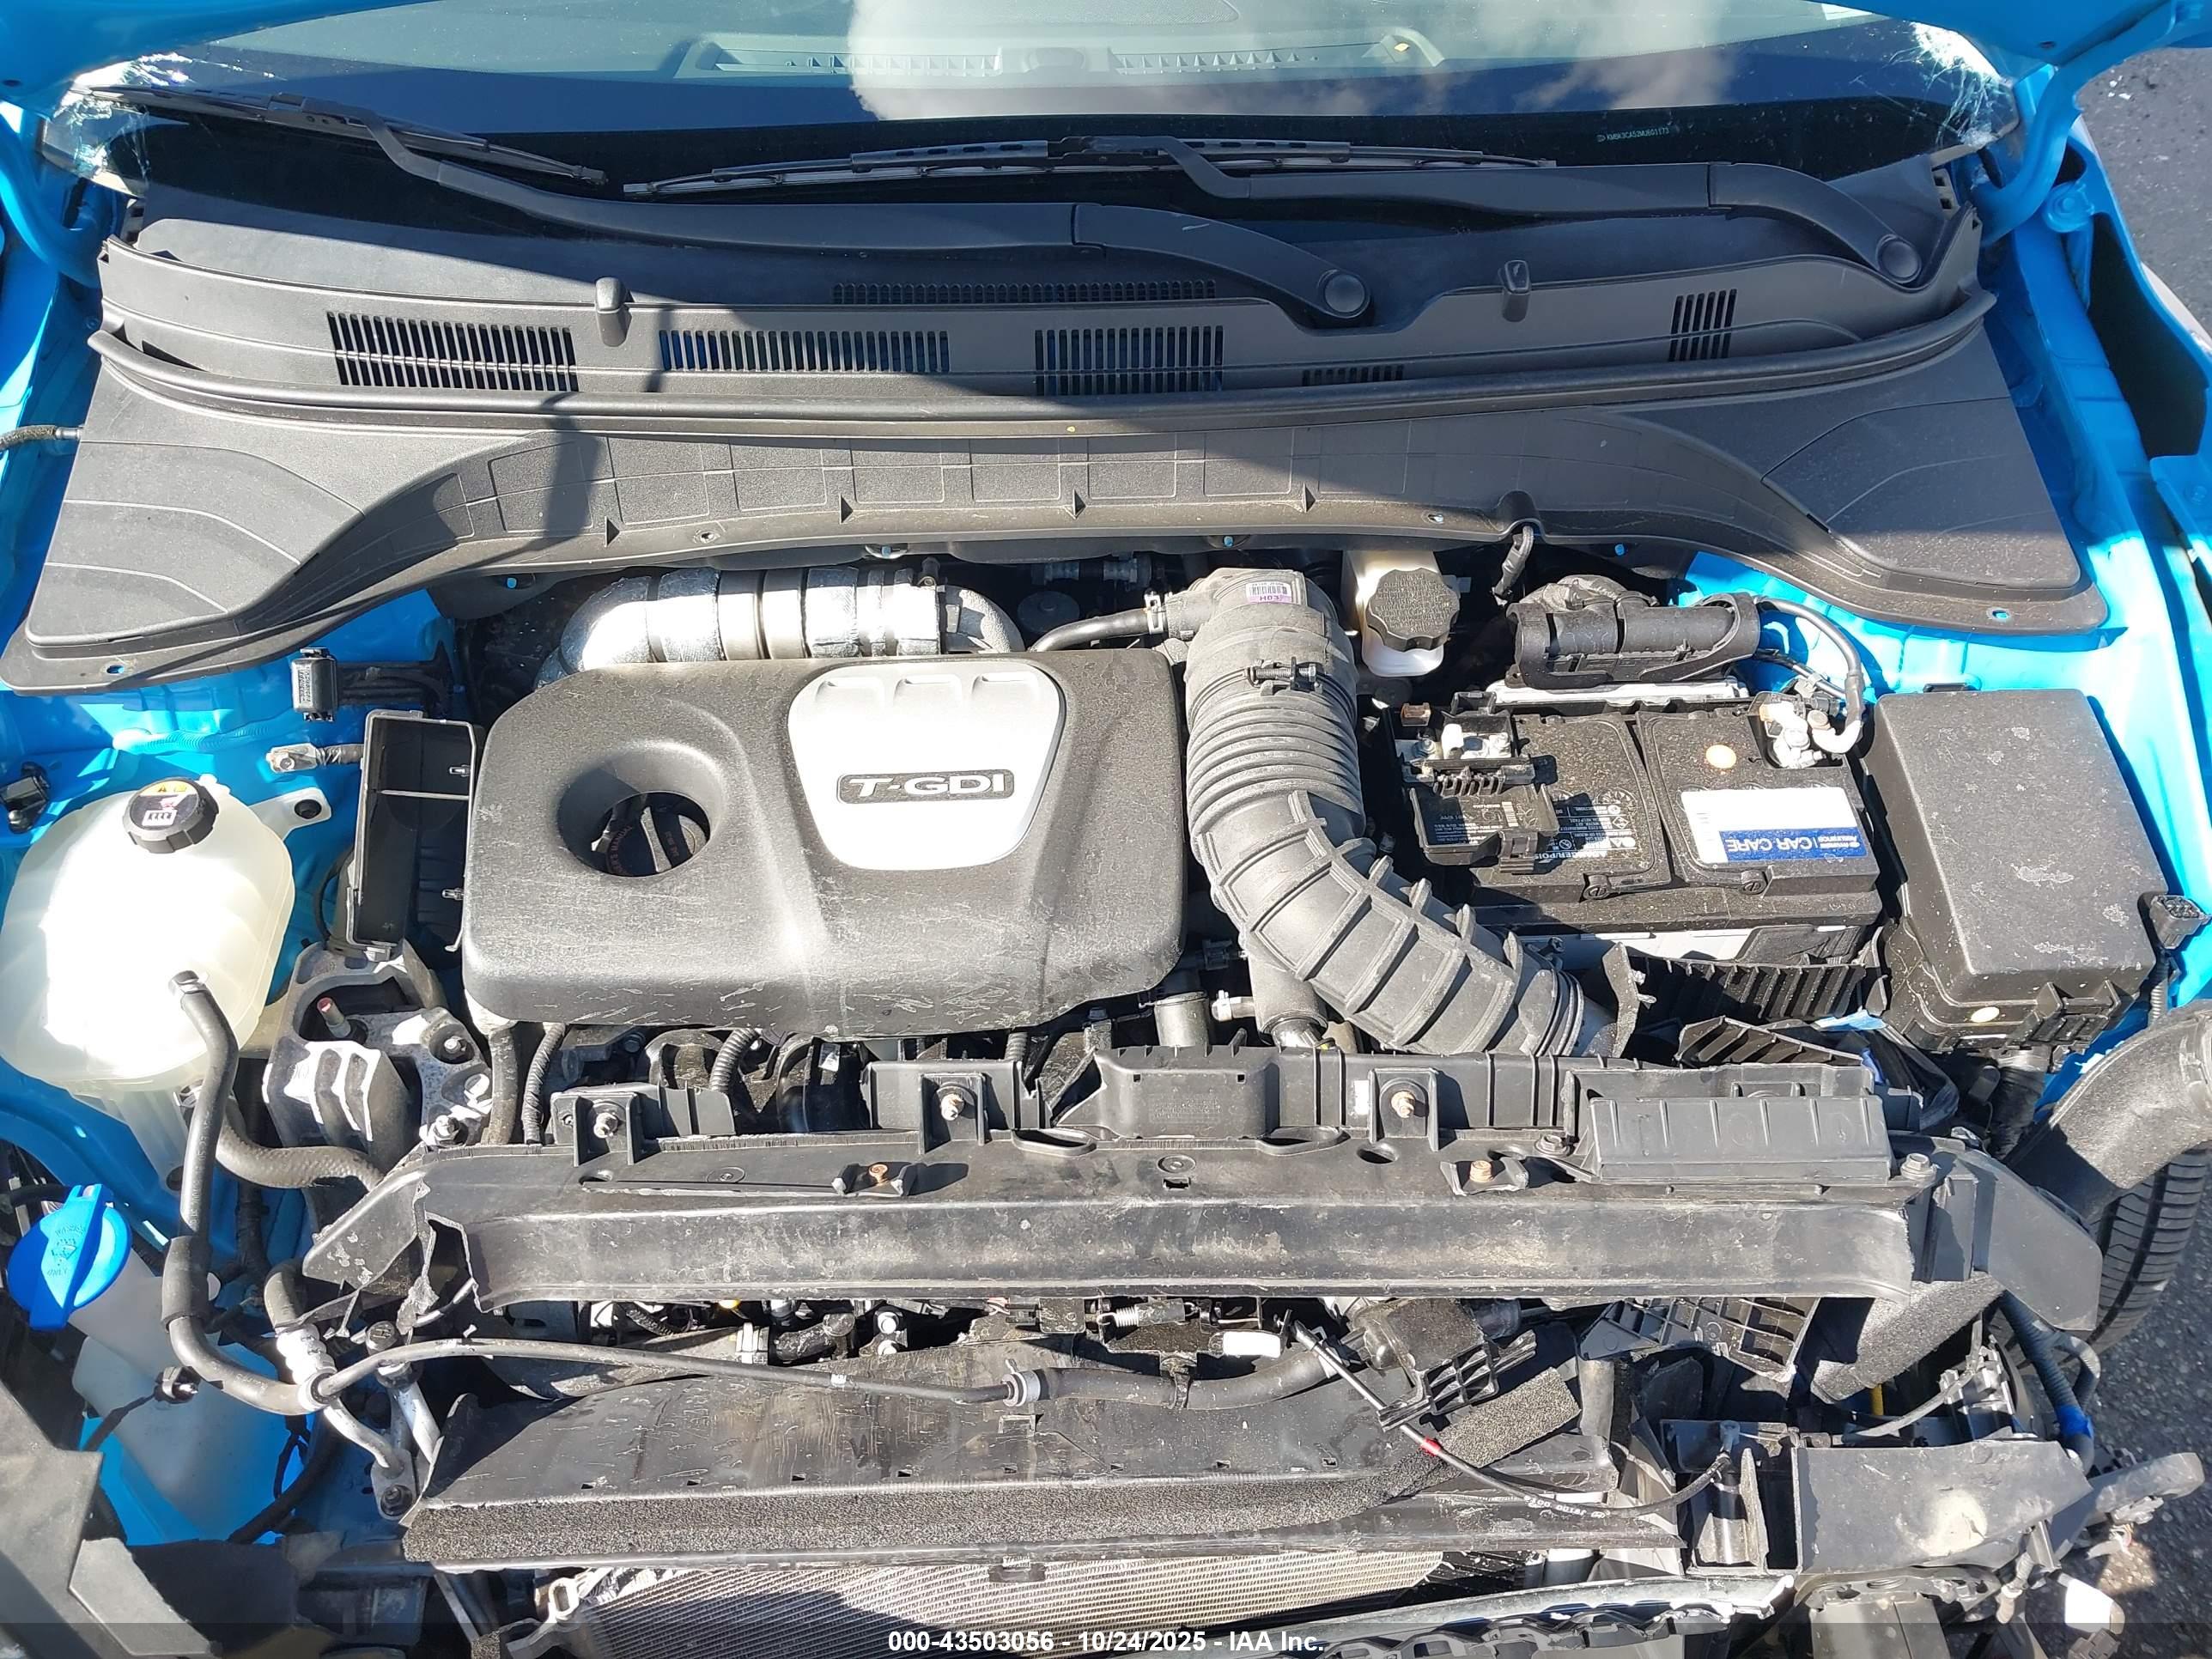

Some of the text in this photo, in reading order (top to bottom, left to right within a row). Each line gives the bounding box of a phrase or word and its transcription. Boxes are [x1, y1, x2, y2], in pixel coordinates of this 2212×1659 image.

[848, 773, 1005, 798] T-GDI
[1725, 836, 1813, 852] CAR CARE
